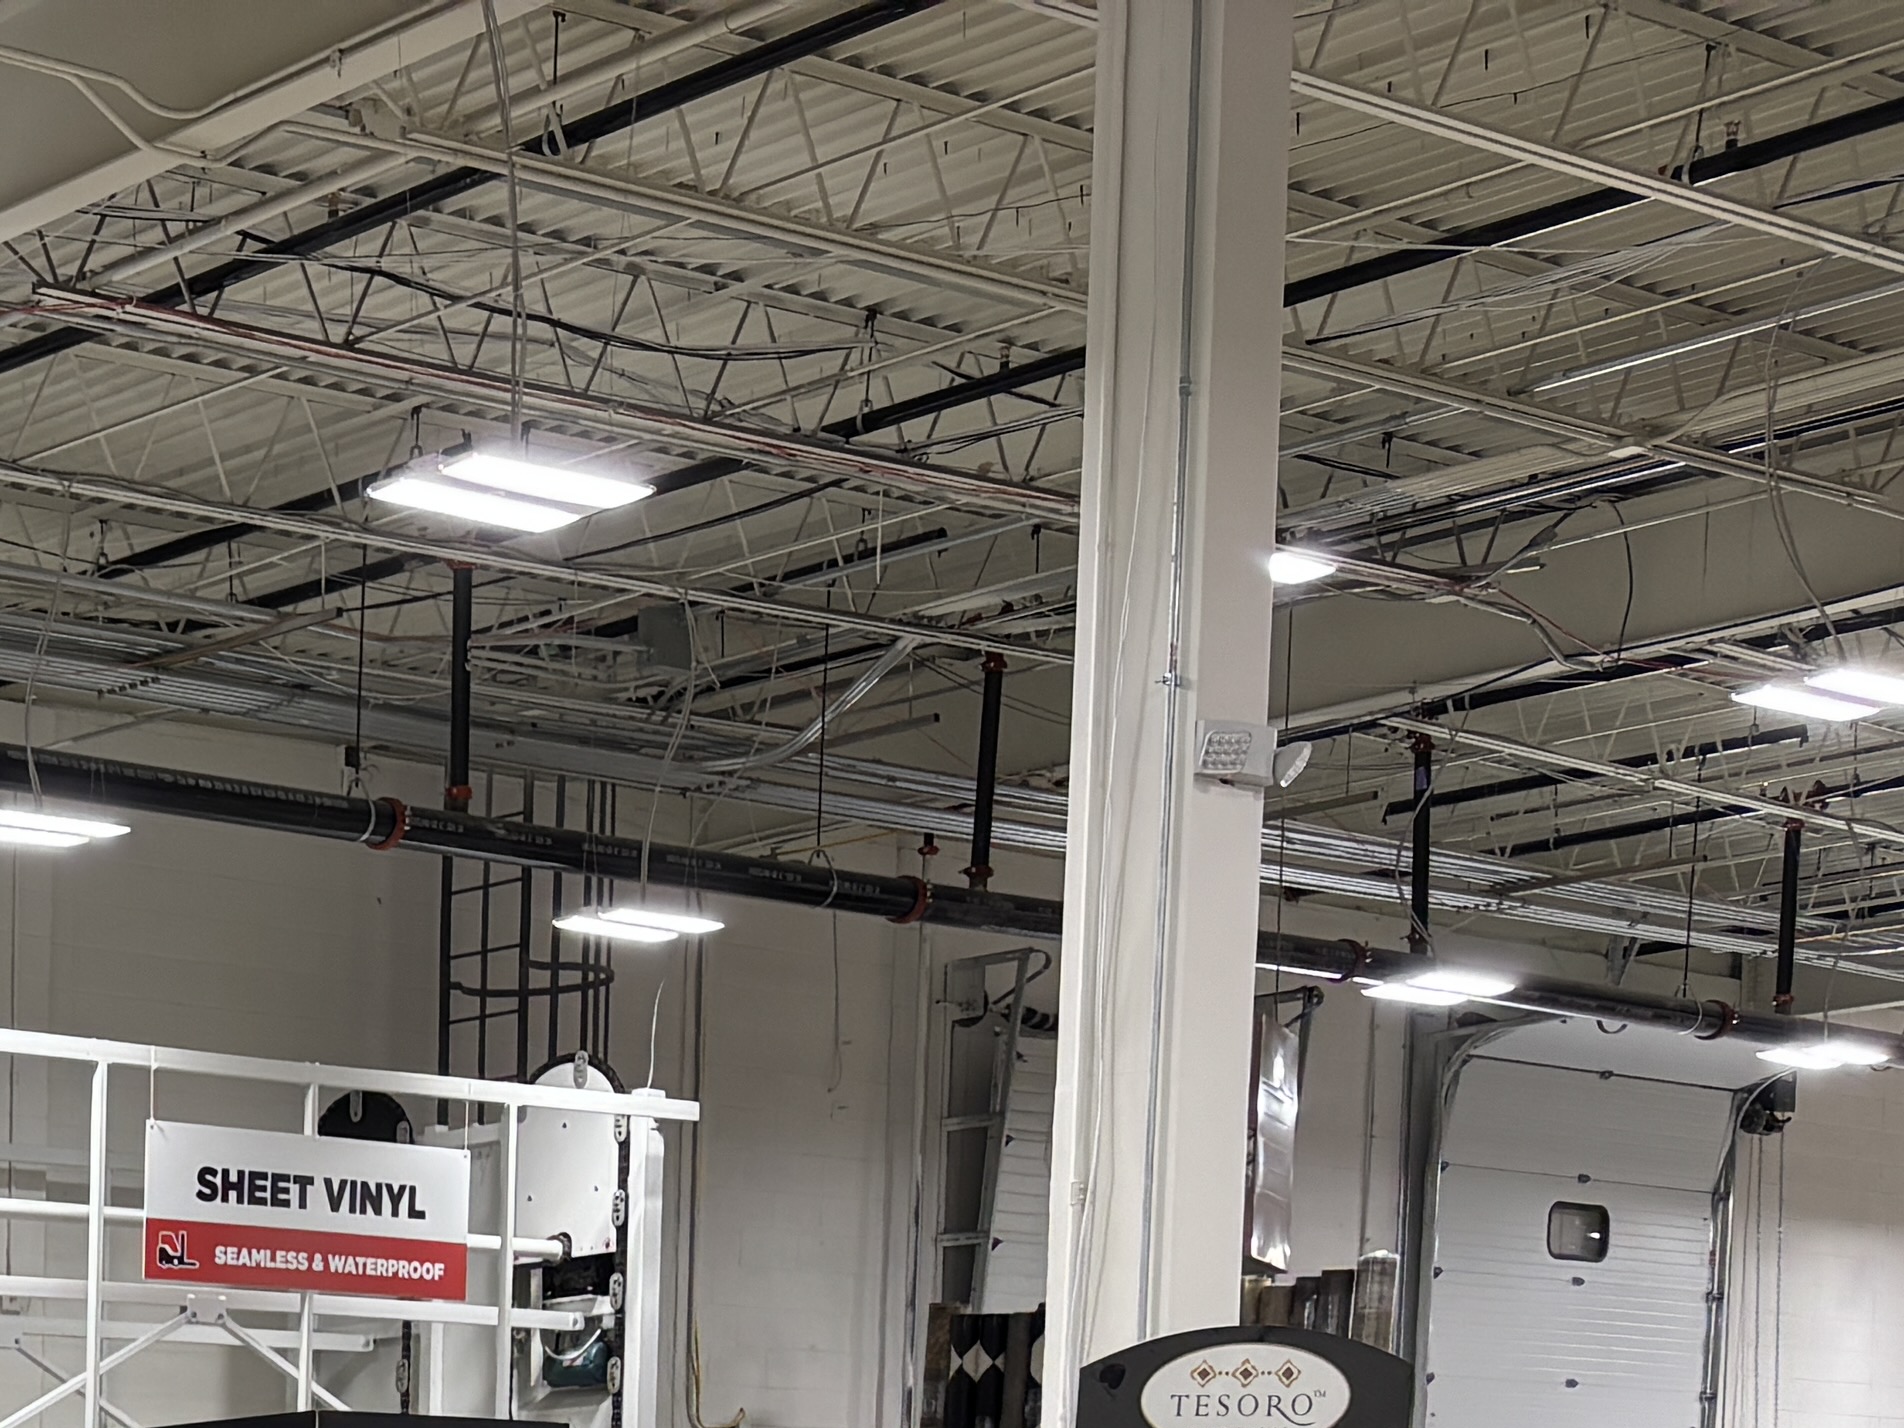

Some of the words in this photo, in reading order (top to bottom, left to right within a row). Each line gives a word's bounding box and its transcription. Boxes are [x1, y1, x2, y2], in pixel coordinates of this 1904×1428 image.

[195, 1166, 315, 1210] SHEET
[323, 1176, 427, 1220] VINYL
[214, 1244, 310, 1273] SEAMLESS
[310, 1251, 324, 1272] &
[327, 1251, 446, 1282] WATERPROOF
